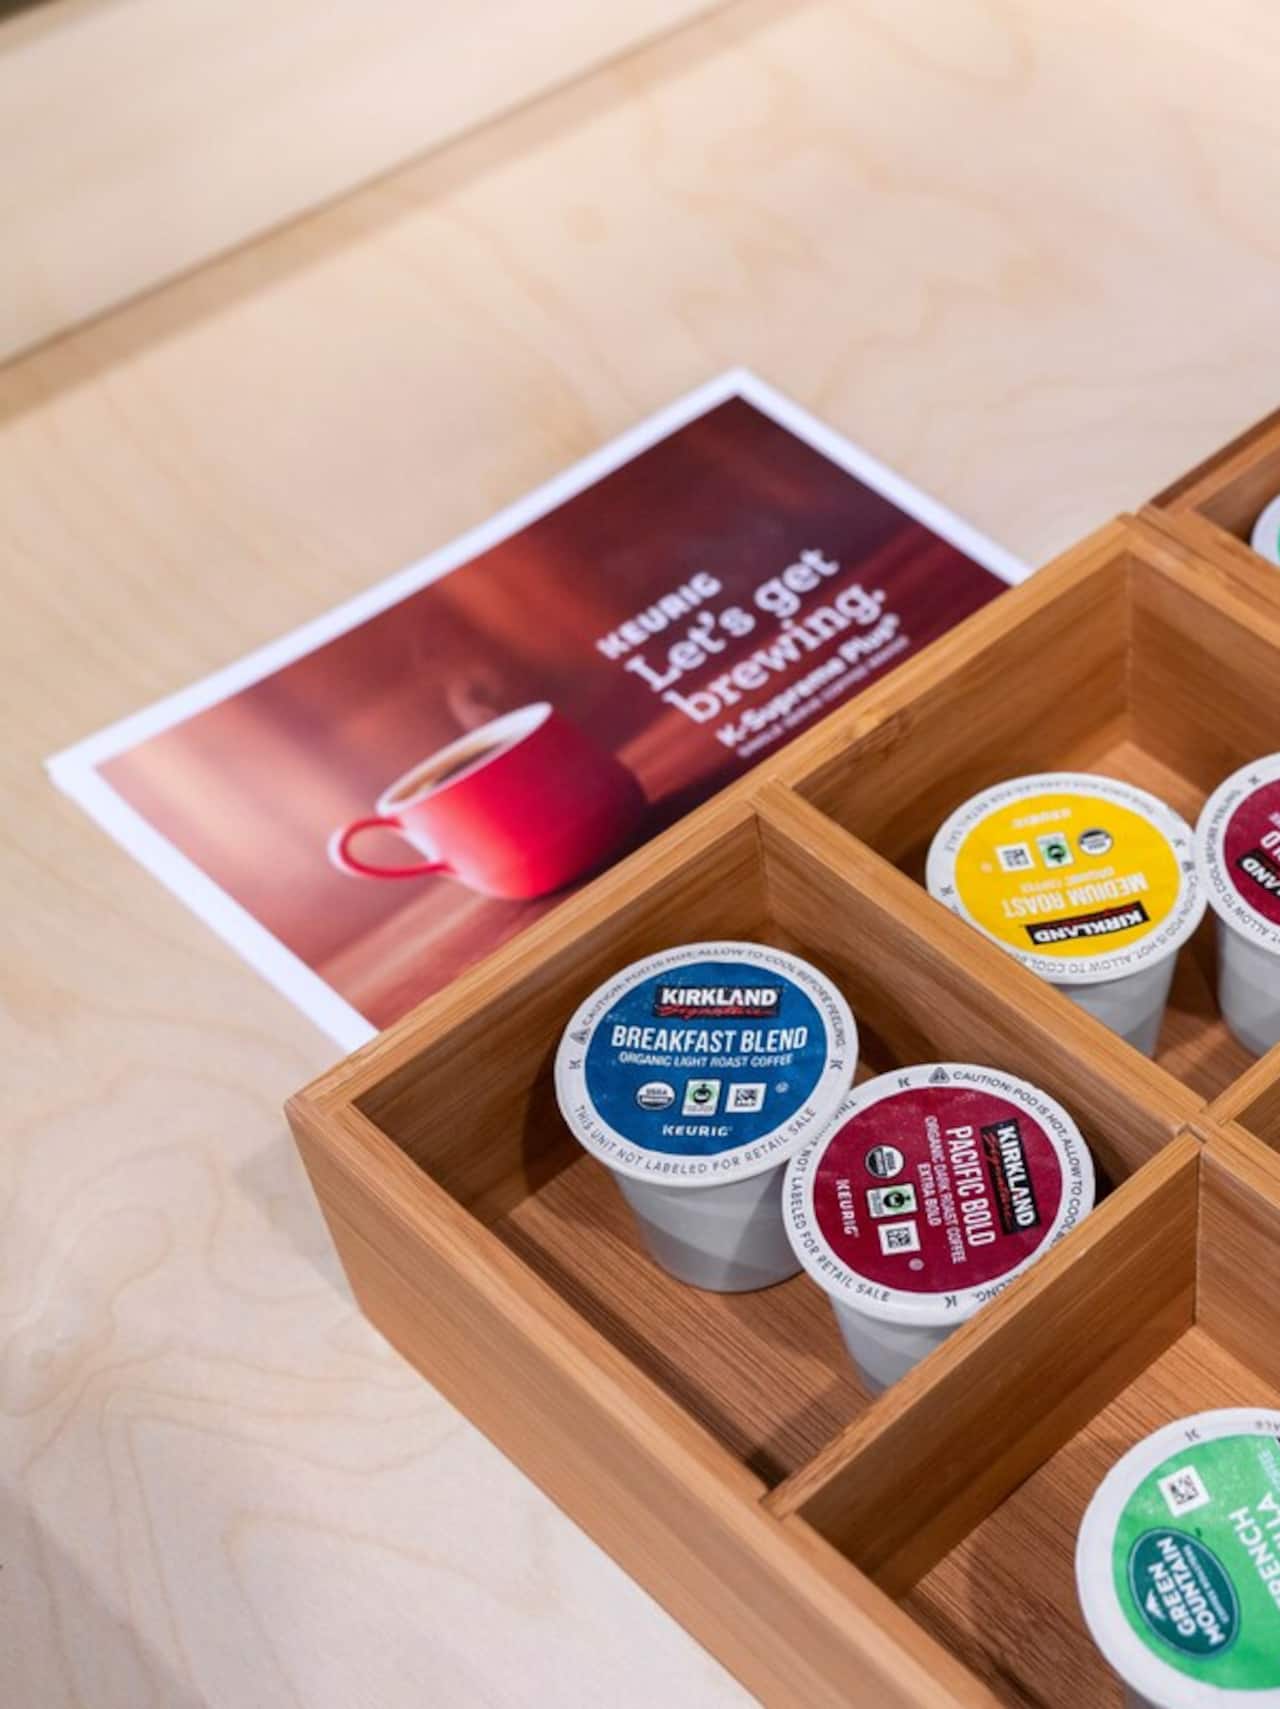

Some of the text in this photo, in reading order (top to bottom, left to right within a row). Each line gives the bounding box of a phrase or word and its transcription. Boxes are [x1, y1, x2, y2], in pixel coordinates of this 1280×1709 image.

[595, 571, 722, 661] KEURIG
[625, 548, 840, 693] Let's get
[662, 583, 886, 724] brewing.
[1002, 892, 1065, 919] ROAST
[1066, 871, 1149, 908] MEDIUM
[1033, 908, 1143, 944] KIRKLAND
[661, 987, 778, 1007] KIRKLAND
[611, 1024, 809, 1053] BREAKFAST BLEND
[618, 1052, 794, 1068] ORGANIC LIGHT ROAST COFFEE
[952, 1070, 1012, 1093] CAUTION:
[1013, 1087, 1038, 1107] POD
[662, 1125, 729, 1137] KEURIG
[1036, 1104, 1050, 1115] IS
[616, 1149, 643, 1165] NOT
[645, 1159, 707, 1175] LABELED
[712, 1156, 740, 1171] FOR
[744, 1135, 789, 1159] RETAIL
[788, 1107, 816, 1135] SALE
[945, 1125, 985, 1197] PACIFIC
[1063, 1136, 1082, 1179] ALLOW
[997, 1124, 1036, 1227] KIRKLAND
[1070, 1179, 1083, 1196] TO
[835, 1179, 857, 1236] KEURIG
[961, 1195, 996, 1248] BOLD
[791, 1176, 807, 1229] LABELED
[800, 1230, 820, 1255] FOR
[816, 1254, 853, 1289] RETAIL
[855, 1283, 890, 1302] SALE
[1148, 1562, 1197, 1638] GREEN
[1157, 1536, 1225, 1647] MOUNTAIN
